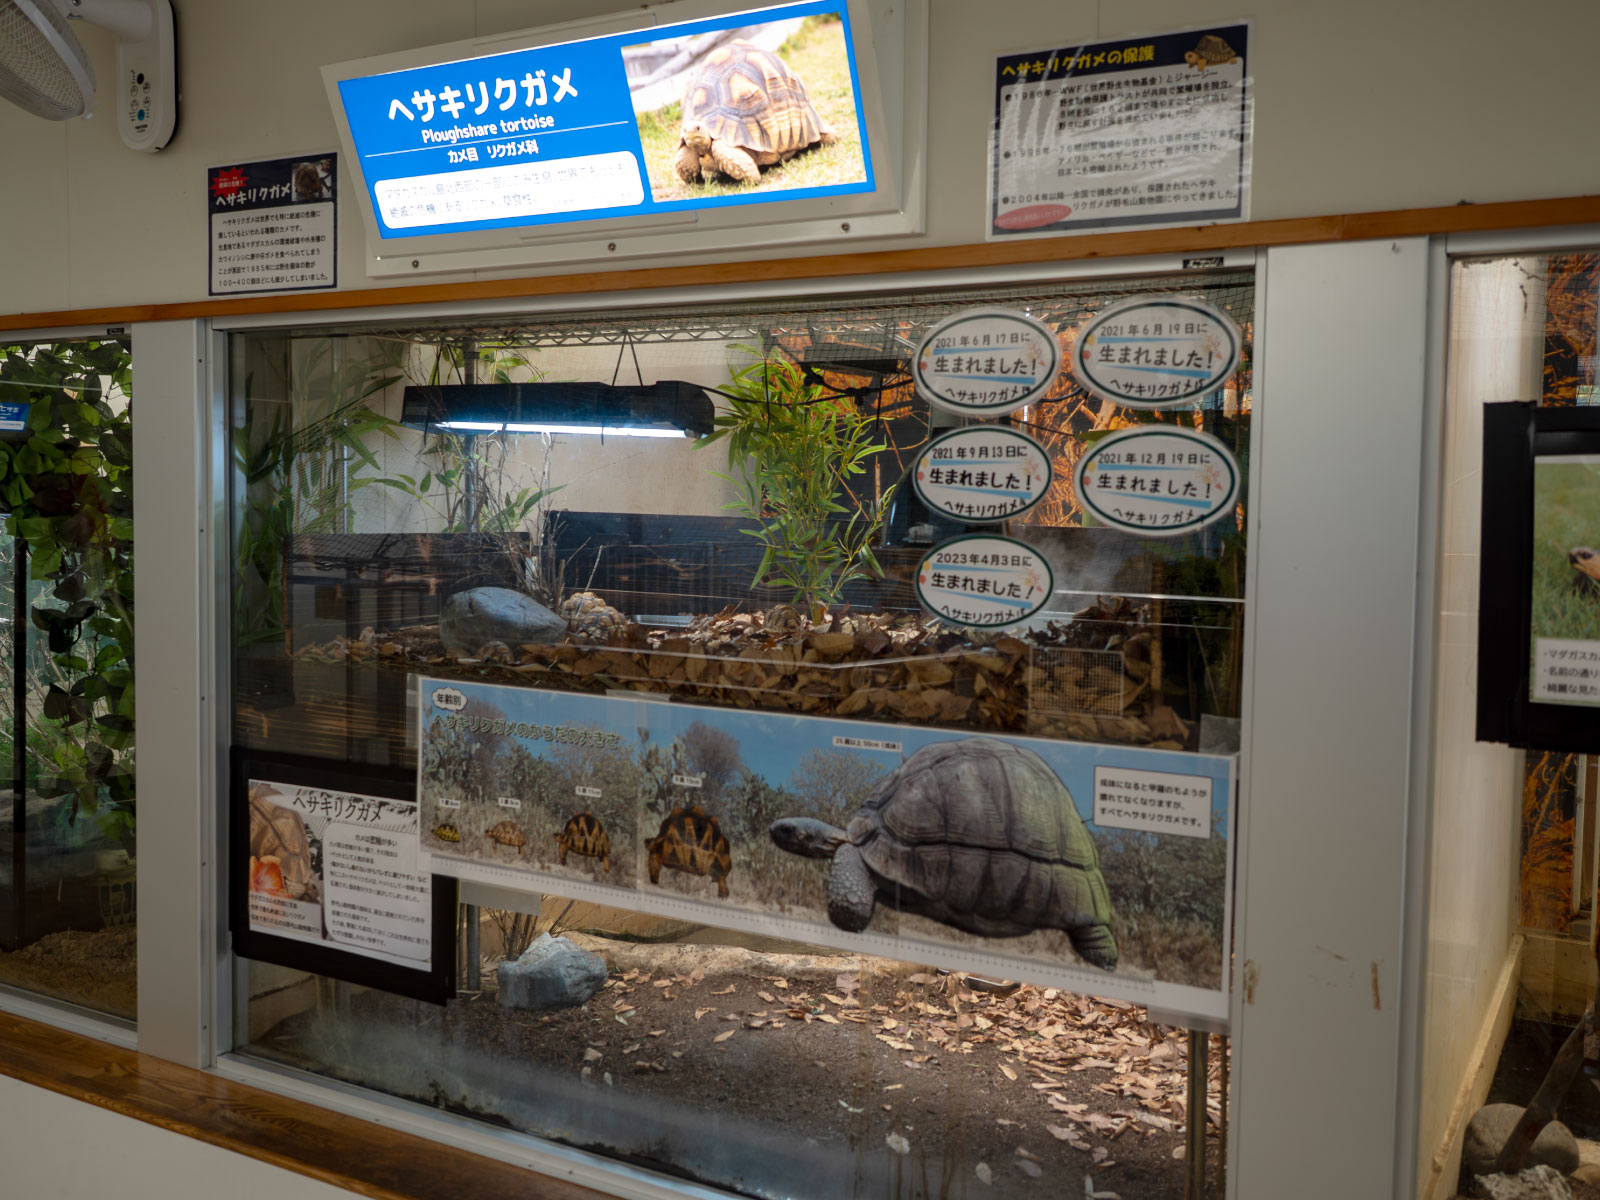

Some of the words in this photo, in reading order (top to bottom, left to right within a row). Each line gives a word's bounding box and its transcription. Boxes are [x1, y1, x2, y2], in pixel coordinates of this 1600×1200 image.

[1001, 44, 1155, 77] ヘサキリクガメの保護
[387, 66, 579, 124] ヘサキリクガメ
[421, 121, 498, 146] Ploughshare
[499, 114, 555, 134] tortoise
[447, 146, 479, 164] カメ目
[487, 138, 539, 161] リクガメ科
[215, 182, 292, 207] ヘサキリクガメ
[933, 356, 1037, 376] 生まれました!
[1097, 344, 1213, 370] 生まれました!
[929, 467, 1032, 491] 生まれました!
[1097, 472, 1212, 499] 生まれました!
[936, 552, 1032, 567] 2023年4月3日に
[931, 572, 1034, 599] 生まれました!
[436, 692, 462, 707] 年齢別
[432, 713, 621, 749] ヘサキリクガメのからだの大きさ
[292, 797, 382, 823] ヘサキリクガメ
